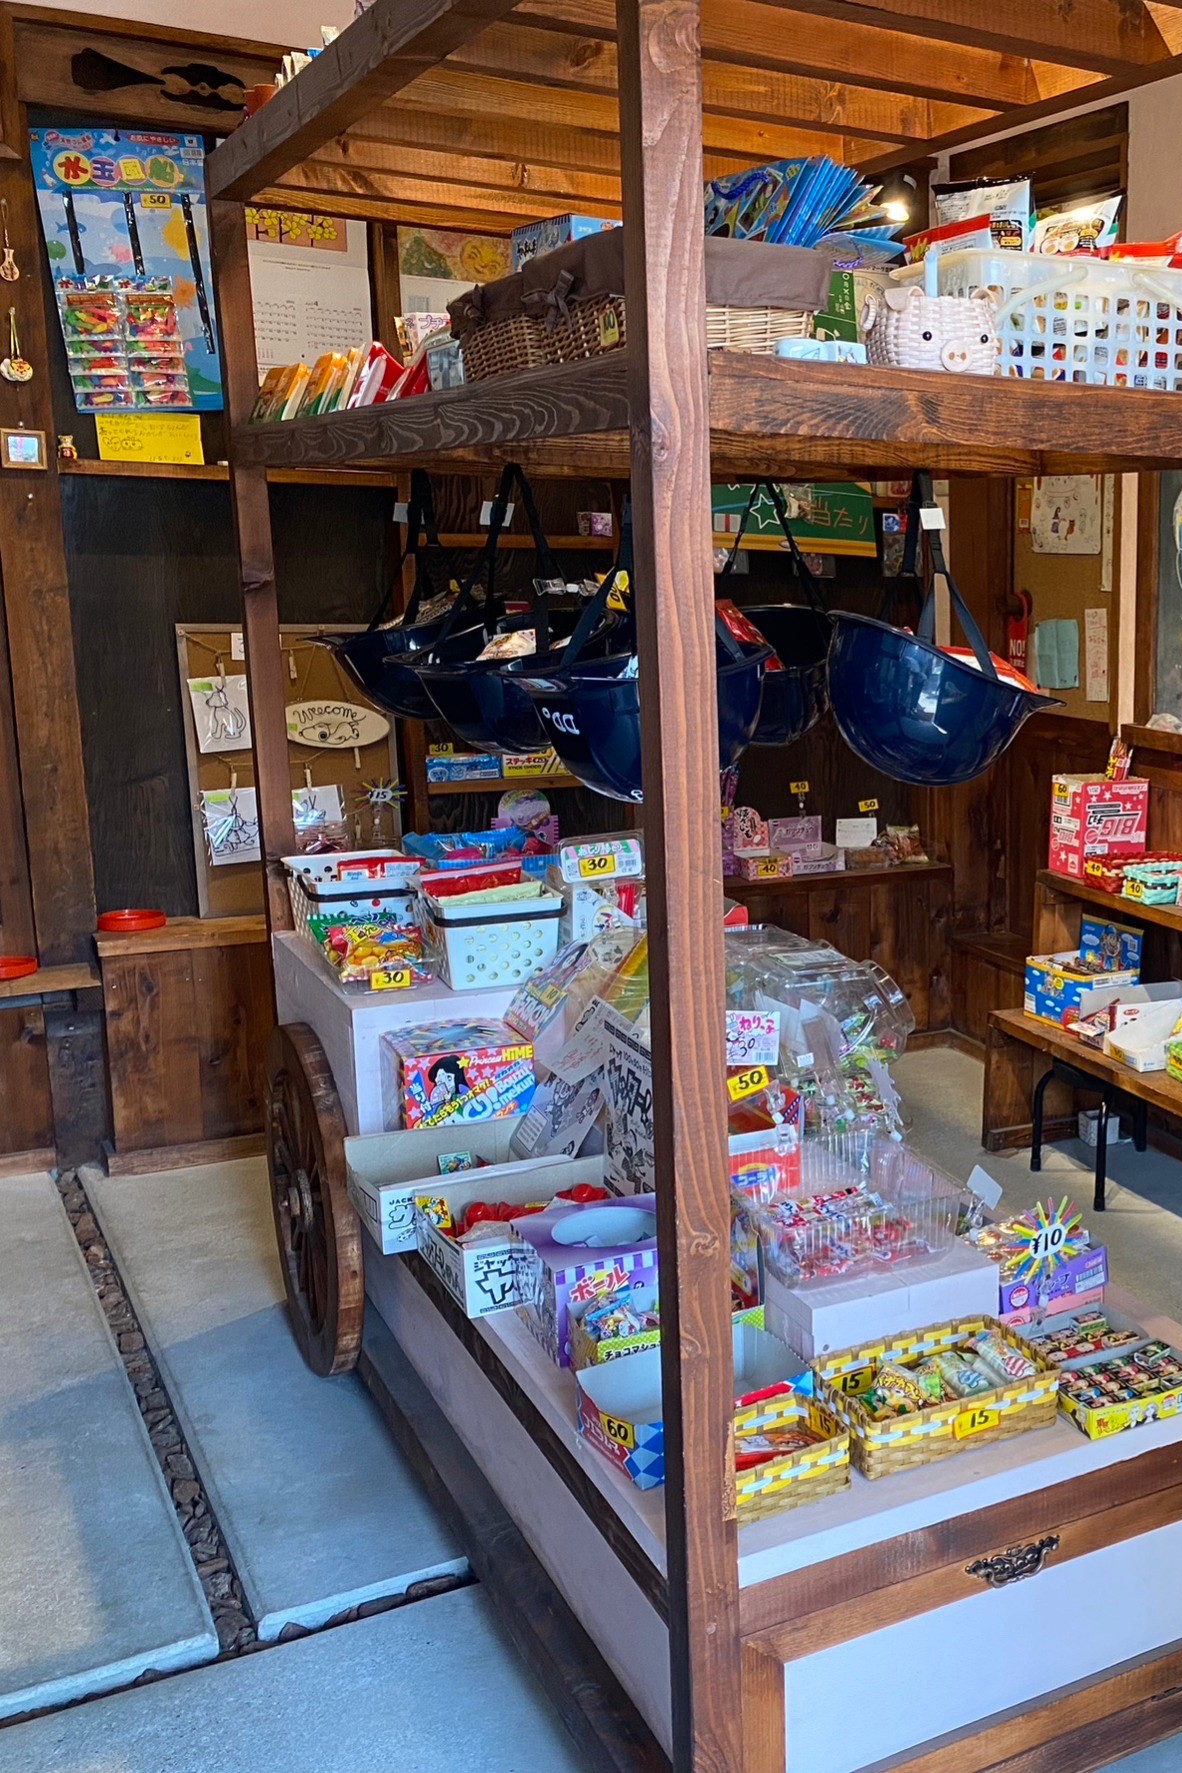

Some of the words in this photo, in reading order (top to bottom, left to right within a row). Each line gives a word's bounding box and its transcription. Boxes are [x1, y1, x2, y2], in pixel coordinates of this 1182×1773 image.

[863, 800, 876, 809] 50
[1101, 817, 1138, 838] BIG
[587, 857, 608, 871] 30
[1129, 883, 1141, 894] 40
[382, 971, 405, 984] 30
[738, 1070, 763, 1090] 50
[1032, 1228, 1063, 1255] ¥10
[841, 1372, 861, 1392] 15
[818, 1415, 832, 1434] 15
[970, 1410, 989, 1428] 15
[606, 1418, 629, 1442] 60
